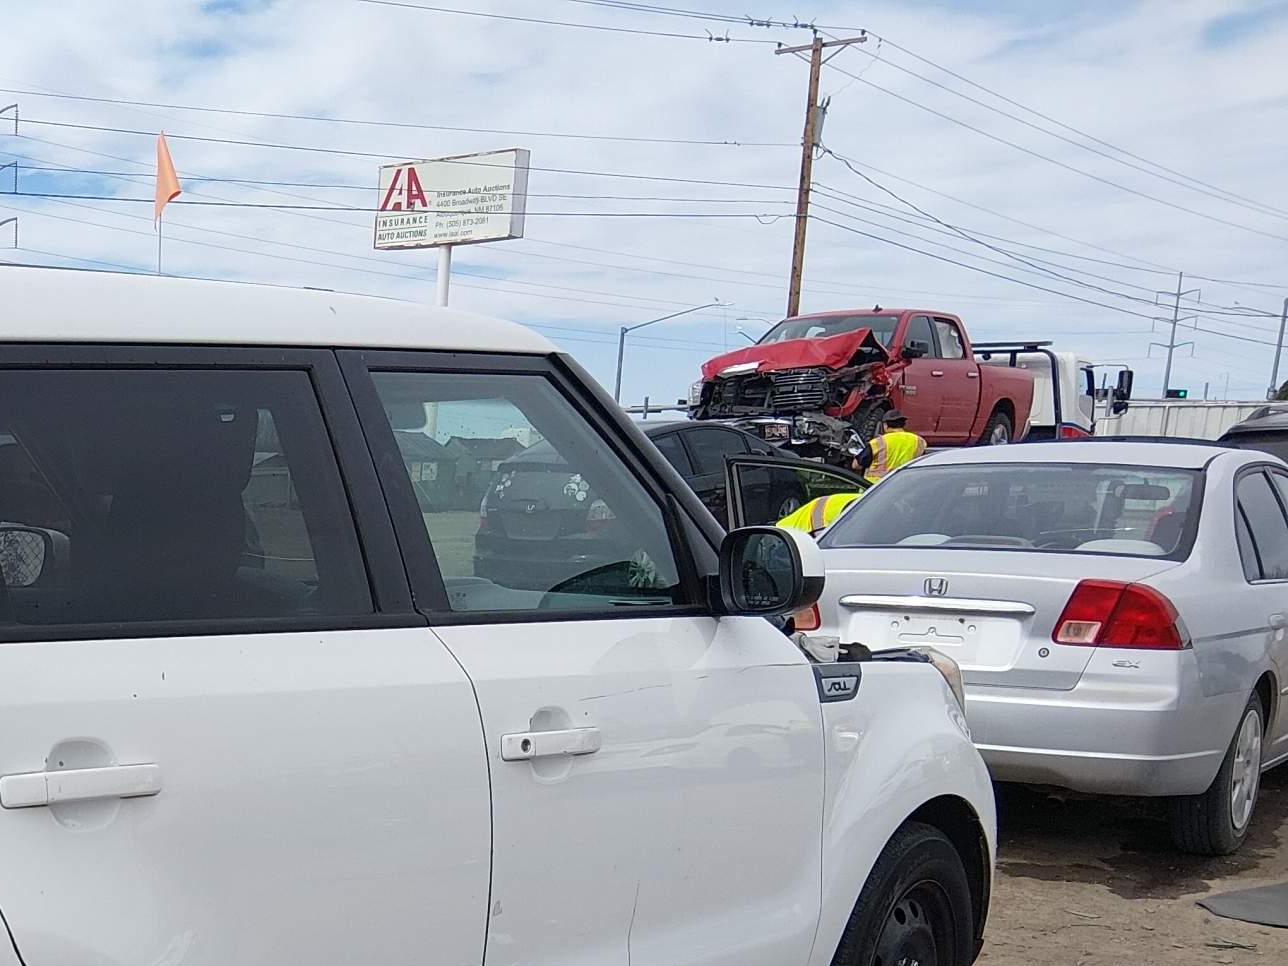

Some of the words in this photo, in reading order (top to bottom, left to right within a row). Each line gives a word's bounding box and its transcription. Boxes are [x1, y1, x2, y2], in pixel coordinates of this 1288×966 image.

[482, 183, 511, 193] Auctions
[452, 196, 479, 207] Broadway
[480, 194, 498, 203] BLVD
[498, 193, 508, 201] SE
[378, 215, 429, 228] INSURANCE
[377, 231, 395, 241] AUTO
[395, 228, 428, 240] AUCTIONS
